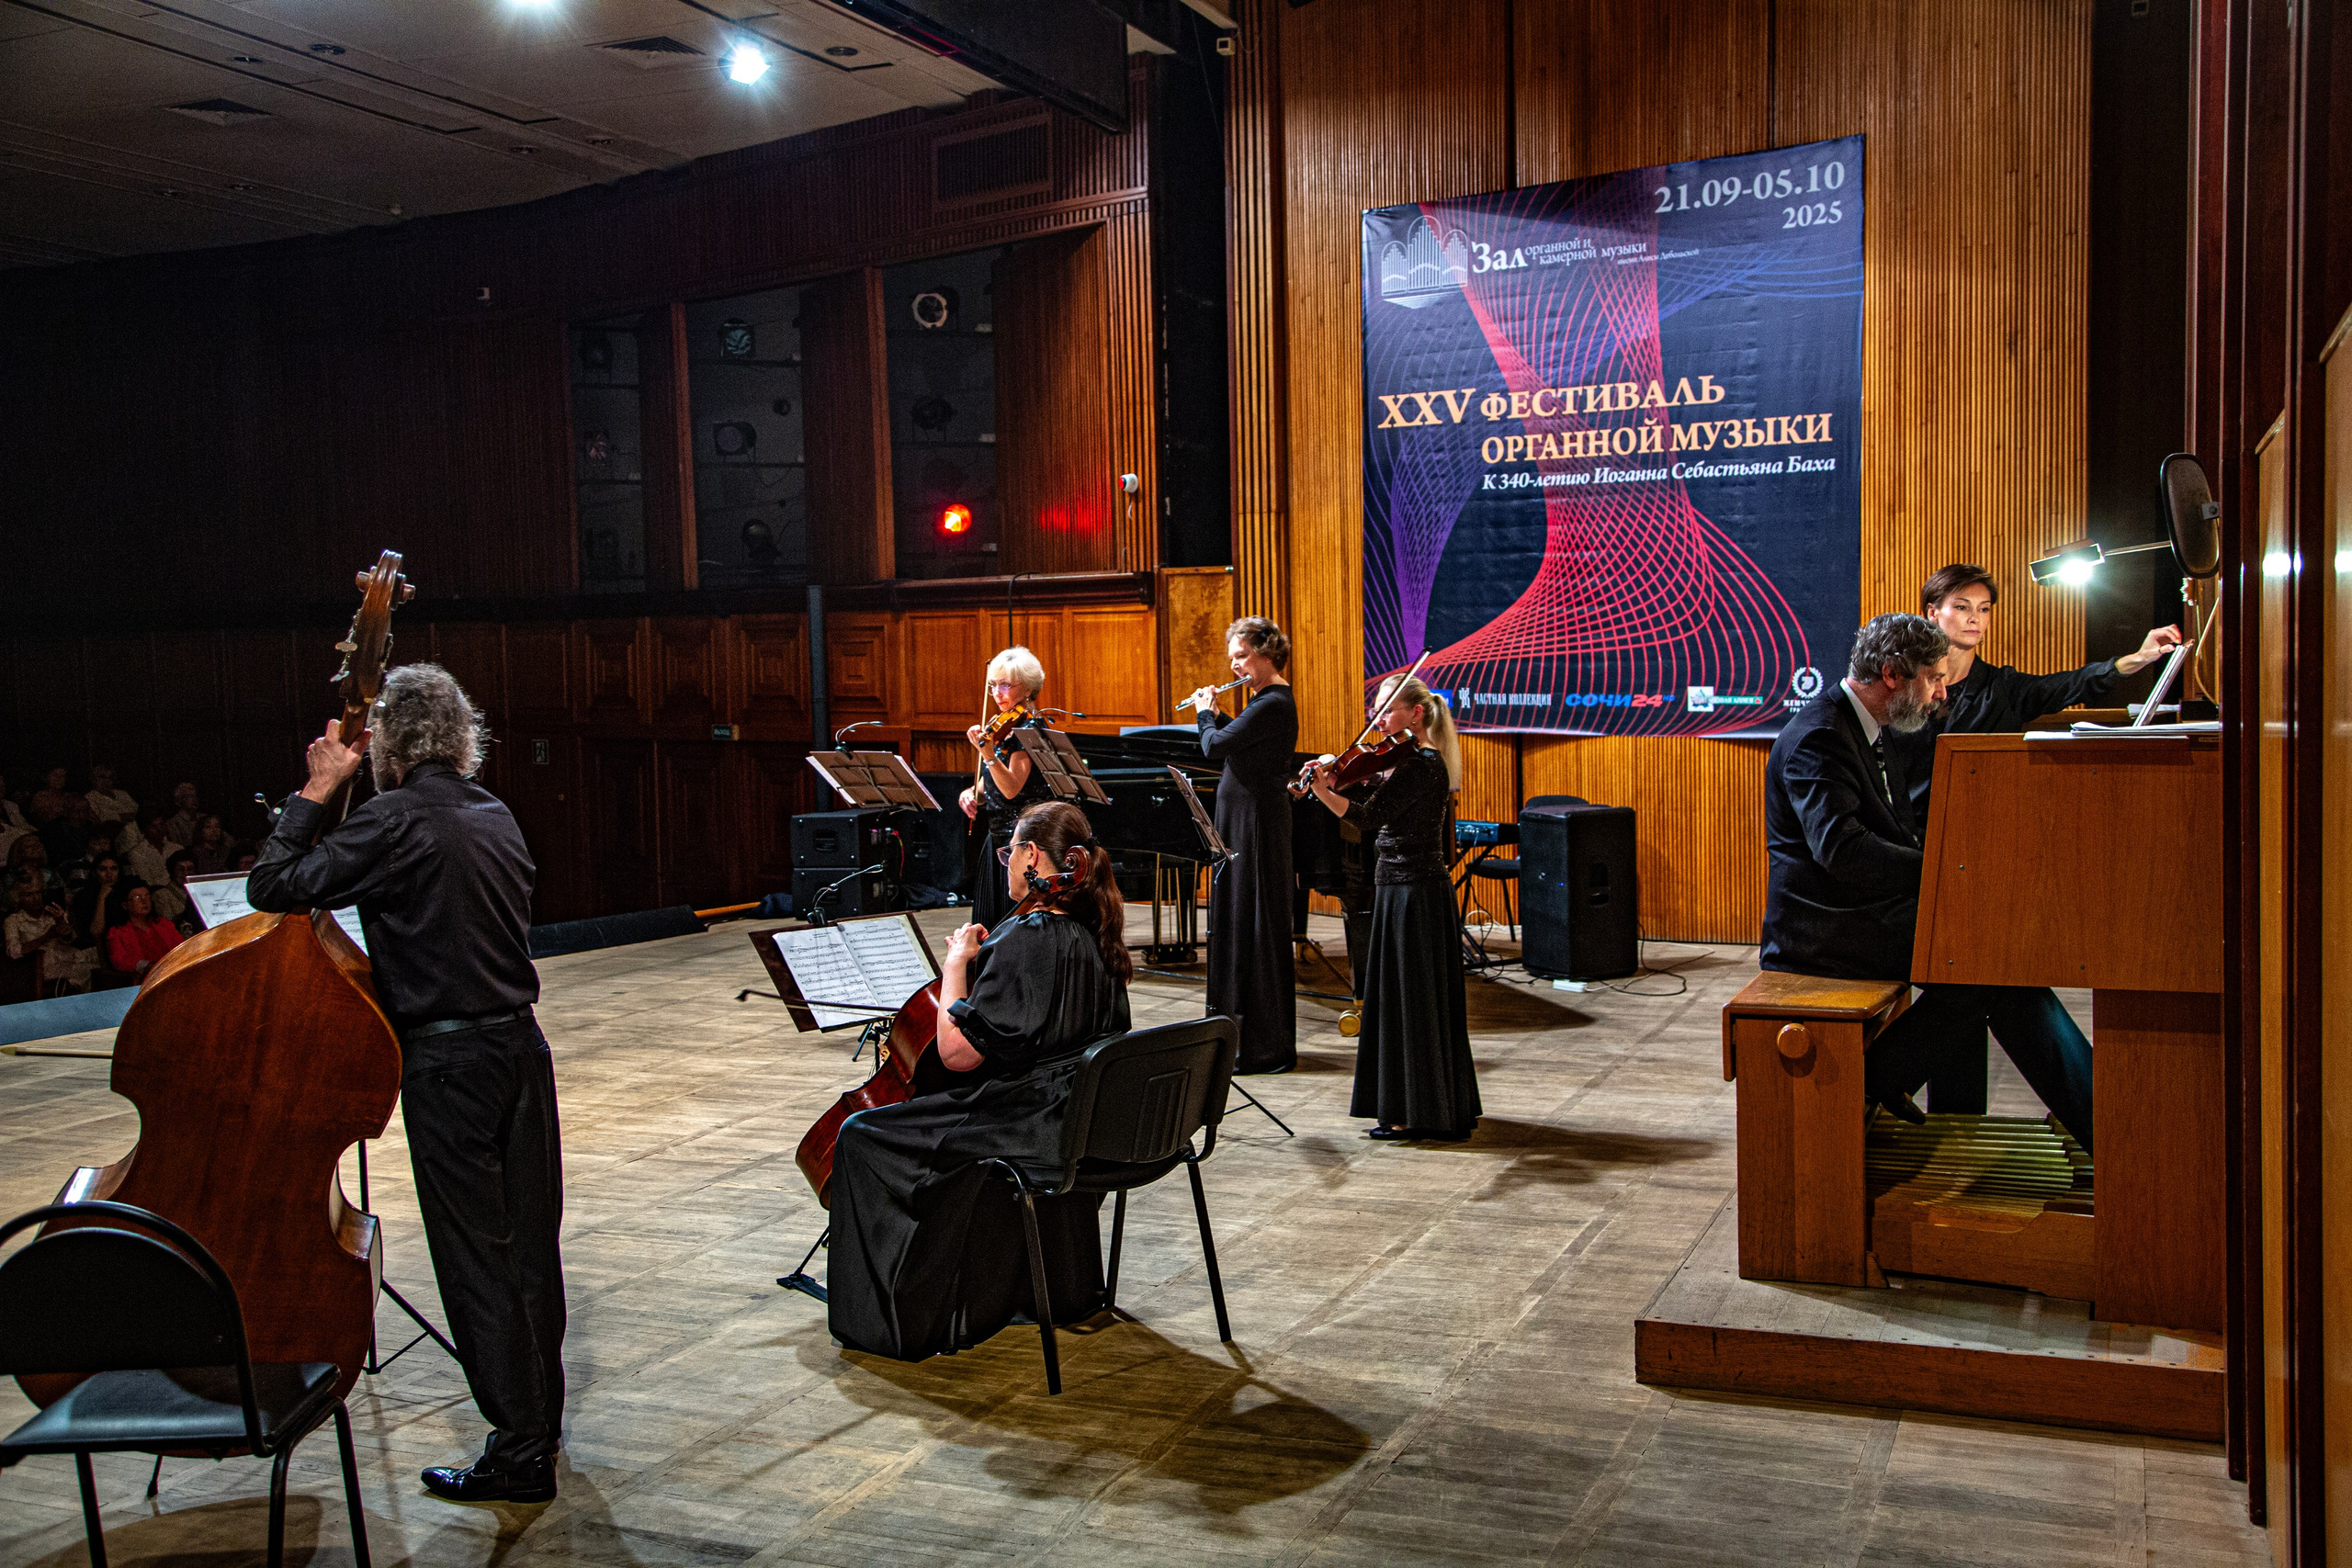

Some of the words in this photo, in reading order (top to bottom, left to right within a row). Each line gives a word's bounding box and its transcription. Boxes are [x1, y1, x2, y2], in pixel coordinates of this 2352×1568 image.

[1654, 161, 1846, 214] 21.09-05.10
[1781, 199, 1844, 230] 2025
[1470, 241, 1529, 274] Зал
[1525, 238, 1581, 260] органной
[1583, 238, 1591, 249] и
[1539, 244, 1598, 266] камерной
[1601, 243, 1647, 262] музыки
[1377, 388, 1476, 429] XXV
[1480, 374, 1725, 422] ФЕСТИВАЛЬ
[1481, 417, 1665, 464] ОРГАННОЙ
[1668, 412, 1834, 452] МУЗЫКИ
[1481, 473, 1497, 491] К
[1498, 471, 1591, 490] 340-летию
[1592, 466, 1668, 485] Иоганна
[1670, 460, 1784, 480] Себастьяна
[1785, 455, 1837, 474] Баха
[1474, 693, 1507, 705] ЧАСТНАЯ
[1508, 693, 1552, 707] КОЛЛЕКЦИЯ
